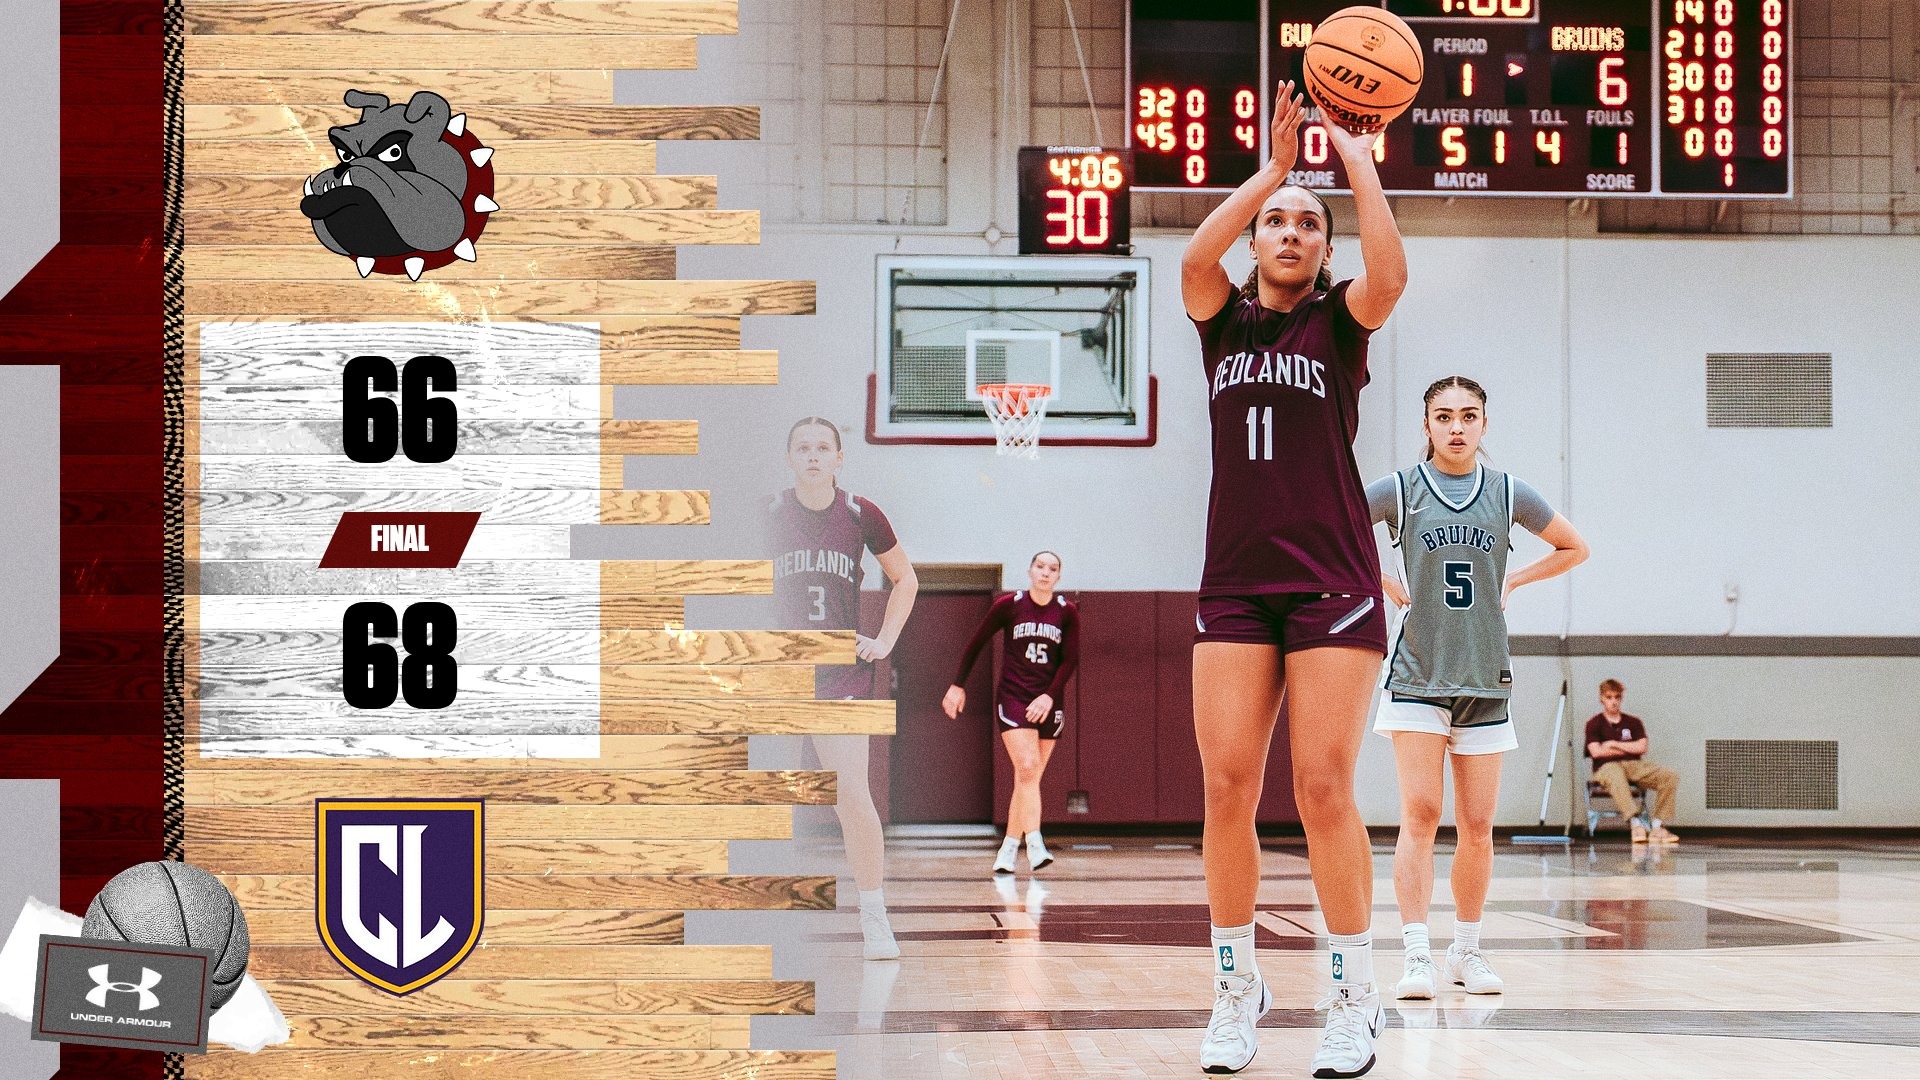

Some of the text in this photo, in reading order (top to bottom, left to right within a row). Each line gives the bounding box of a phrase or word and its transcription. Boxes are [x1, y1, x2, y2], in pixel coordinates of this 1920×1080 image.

[1715, 0, 1732, 26] 0
[1763, 0, 1781, 26] 0
[1433, 38, 1488, 54] PERIOD
[1551, 27, 1625, 51] BRUINS
[1715, 31, 1732, 58] 0
[1763, 31, 1781, 59] 0
[1463, 63, 1473, 97] 1
[1599, 58, 1627, 105] 6
[1667, 62, 1781, 91] 30 0 0
[1139, 88, 1254, 118] 32 0 0
[1412, 108, 1512, 124] PLAYER FOUL
[1586, 109, 1634, 125] FOULS
[1715, 96, 1733, 124] 0
[1763, 96, 1781, 124] 0
[1136, 122, 1254, 150] 45 0 4
[1304, 126, 1328, 164] 0
[1441, 127, 1505, 166] 5 1
[1536, 131, 1560, 164] 4
[1618, 132, 1628, 165] 1
[1685, 128, 1781, 157] 0 0 0
[1050, 156, 1122, 188] 4:06
[1186, 155, 1205, 183] 0
[1286, 170, 1335, 188] SCORE
[1434, 172, 1488, 188] MATCH
[1586, 173, 1635, 190] SCORE
[1725, 163, 1733, 187] 1
[1047, 190, 1108, 244] 30
[1211, 351, 1326, 401] REDLANDS
[1245, 406, 1273, 460] 11
[1421, 524, 1497, 555] BRUINS
[1443, 560, 1475, 610] 5
[808, 585, 826, 621] 3
[1012, 621, 1062, 644] REDLANDS
[1025, 642, 1048, 664] 45
